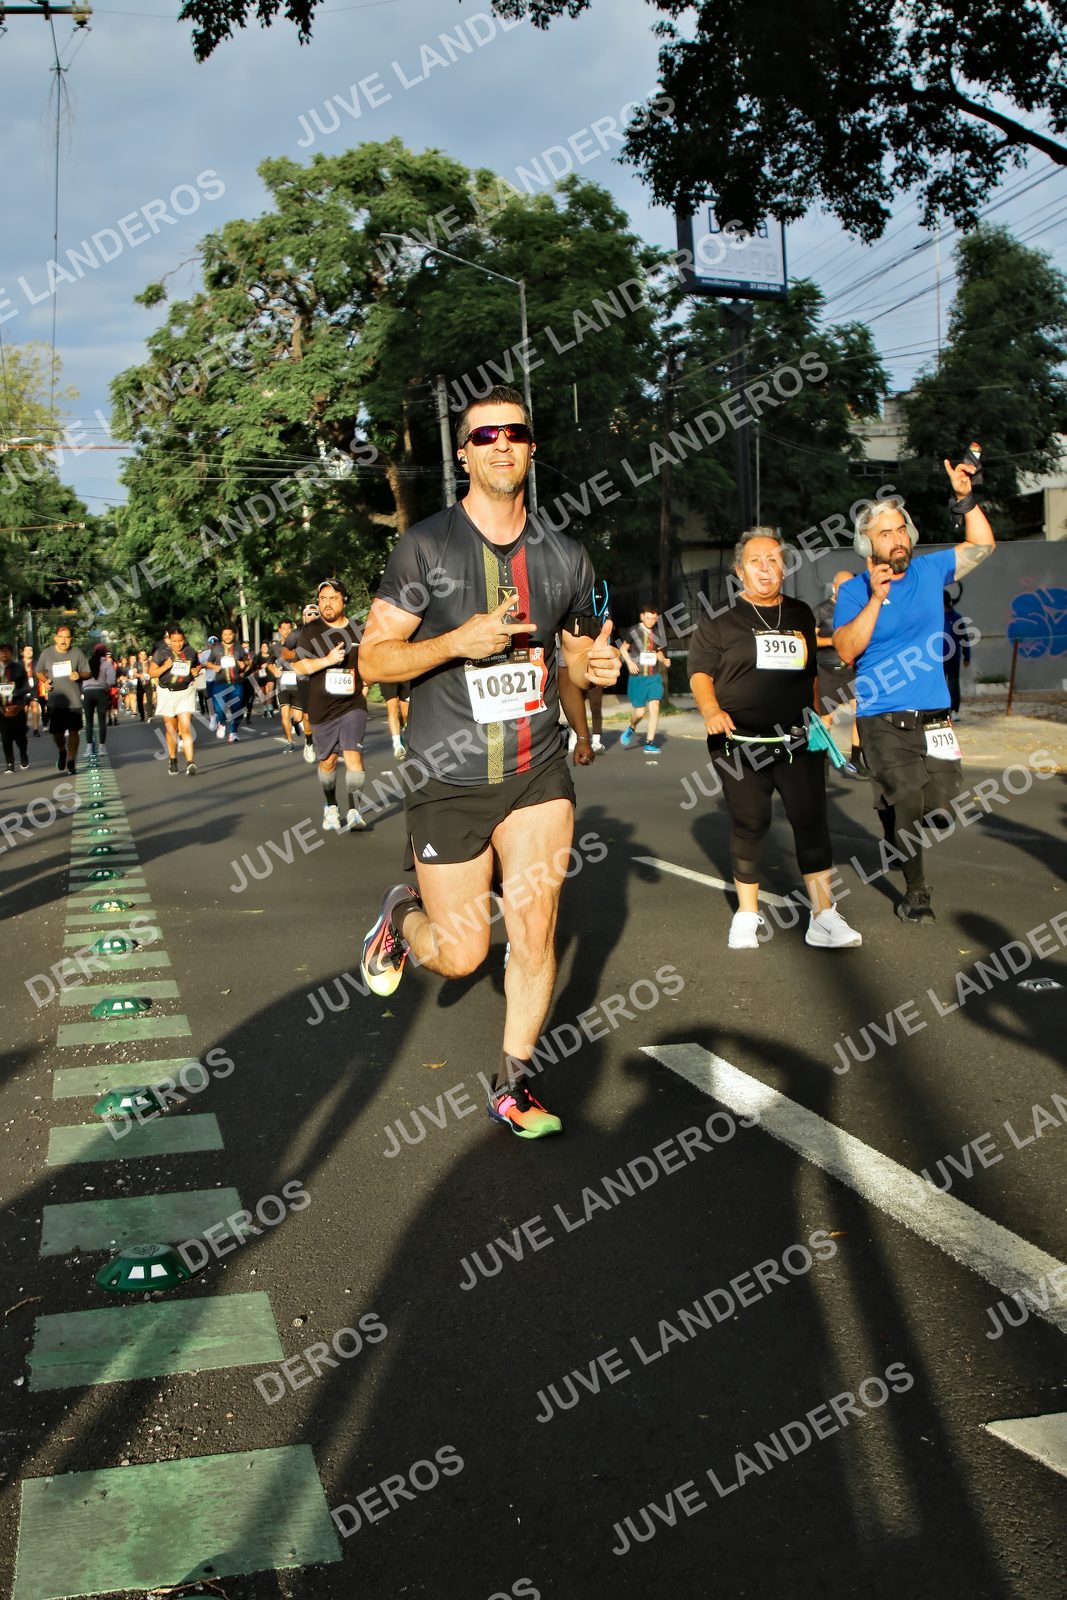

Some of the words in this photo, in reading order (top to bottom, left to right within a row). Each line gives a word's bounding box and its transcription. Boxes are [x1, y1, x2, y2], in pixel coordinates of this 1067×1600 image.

[764, 639, 797, 654] 3916
[472, 670, 537, 699] 10821
[932, 732, 954, 748] 9719
